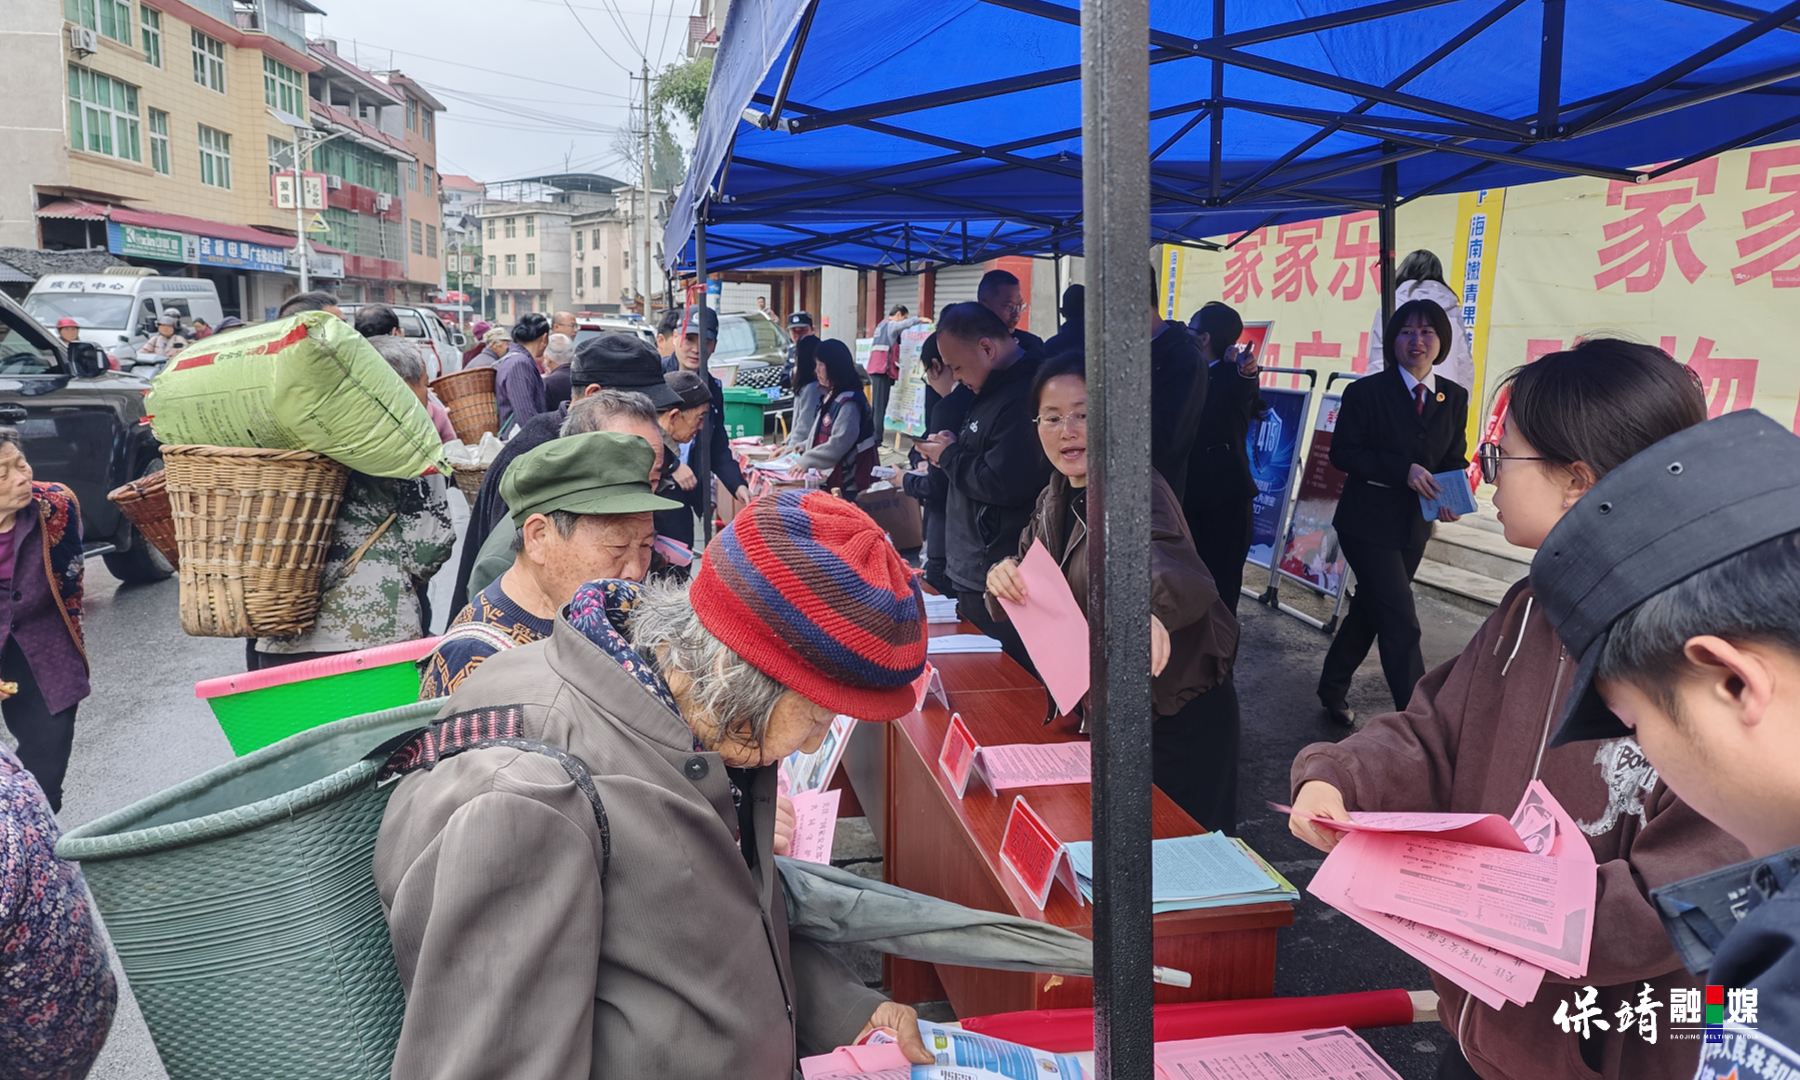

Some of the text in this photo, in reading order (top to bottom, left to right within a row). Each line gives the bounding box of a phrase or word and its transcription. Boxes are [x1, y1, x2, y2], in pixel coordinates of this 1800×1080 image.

[280, 181, 290, 204] 爱国
[1222, 210, 1383, 304] 家家乐
[50, 281, 124, 290] 疾控中心
[1257, 420, 1278, 452] 415
